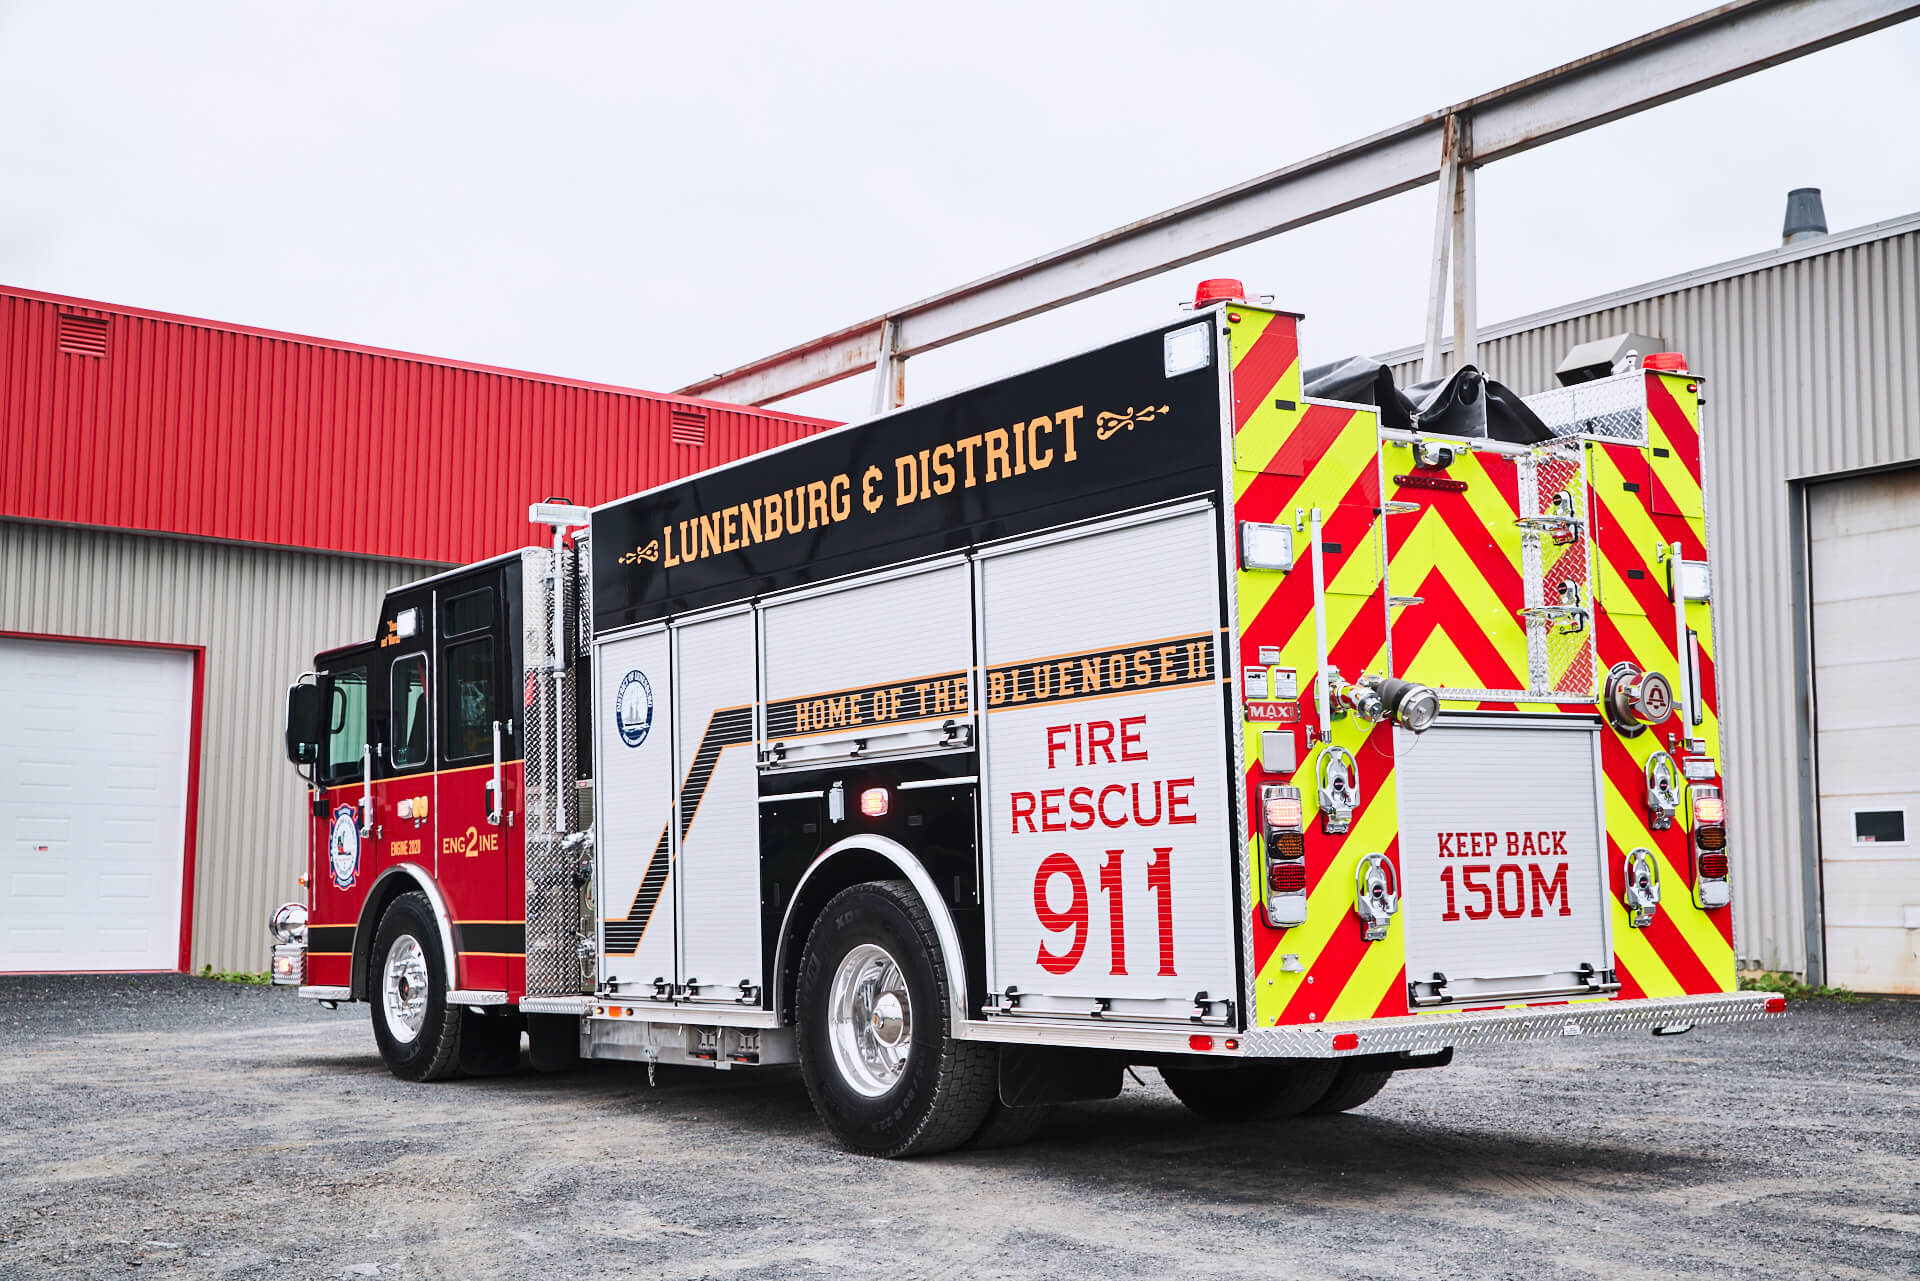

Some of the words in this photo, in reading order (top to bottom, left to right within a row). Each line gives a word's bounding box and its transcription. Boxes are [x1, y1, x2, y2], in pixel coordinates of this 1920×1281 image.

[664, 474, 850, 568] LUNENBURG
[863, 466, 884, 514] &
[896, 405, 1084, 507] DISTRICT
[796, 693, 862, 733] HOME
[873, 687, 902, 721] OF
[914, 678, 968, 716] THE
[990, 645, 1178, 706] BLUENOSE
[1046, 714, 1149, 769] FIRE
[1010, 777, 1197, 834] RESCUE
[1437, 832, 1498, 858] KEEP
[1506, 831, 1568, 857] BACK
[1033, 847, 1178, 977] 911
[1440, 862, 1572, 922] 150M
